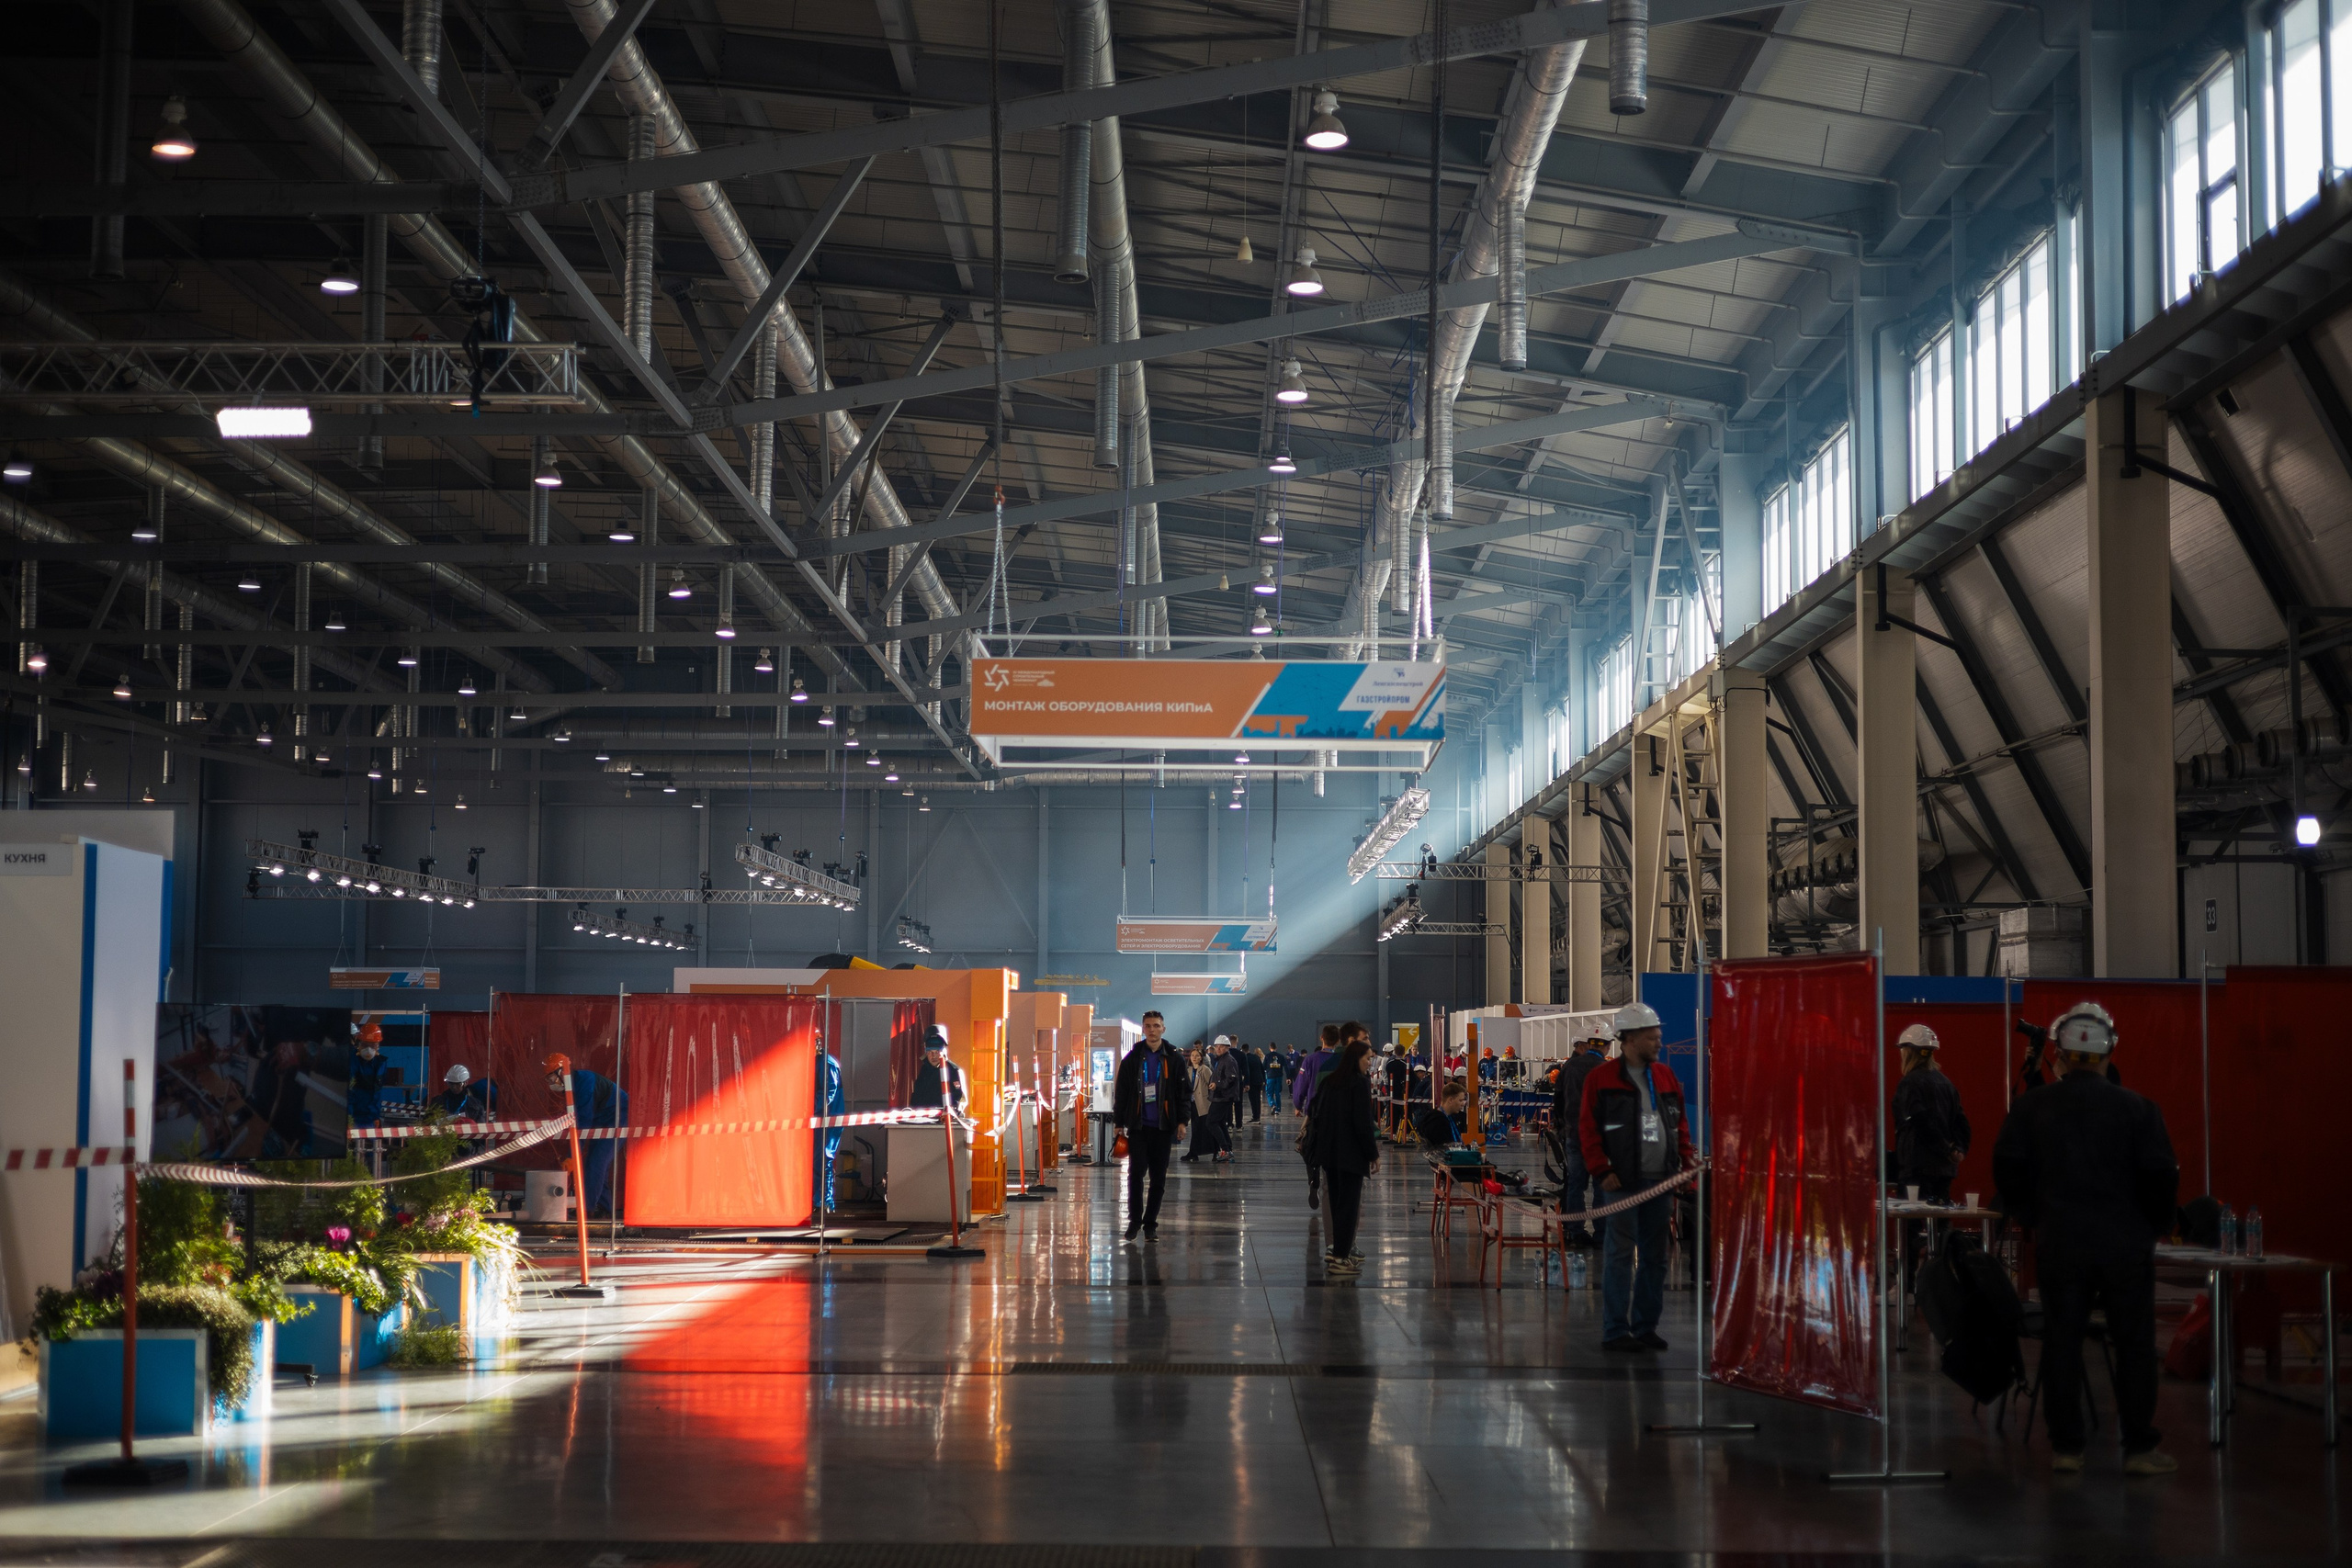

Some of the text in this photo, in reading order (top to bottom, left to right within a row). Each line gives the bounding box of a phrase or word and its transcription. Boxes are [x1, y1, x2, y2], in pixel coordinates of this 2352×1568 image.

[1356, 694, 1411, 704] ГАЗСТРОЙПРОМ
[984, 700, 1214, 714] МОНТАЖ ОБОРУДОВАНИЯ КИПиА
[4, 853, 46, 863] КУХНЯ
[2206, 907, 2216, 925] 33
